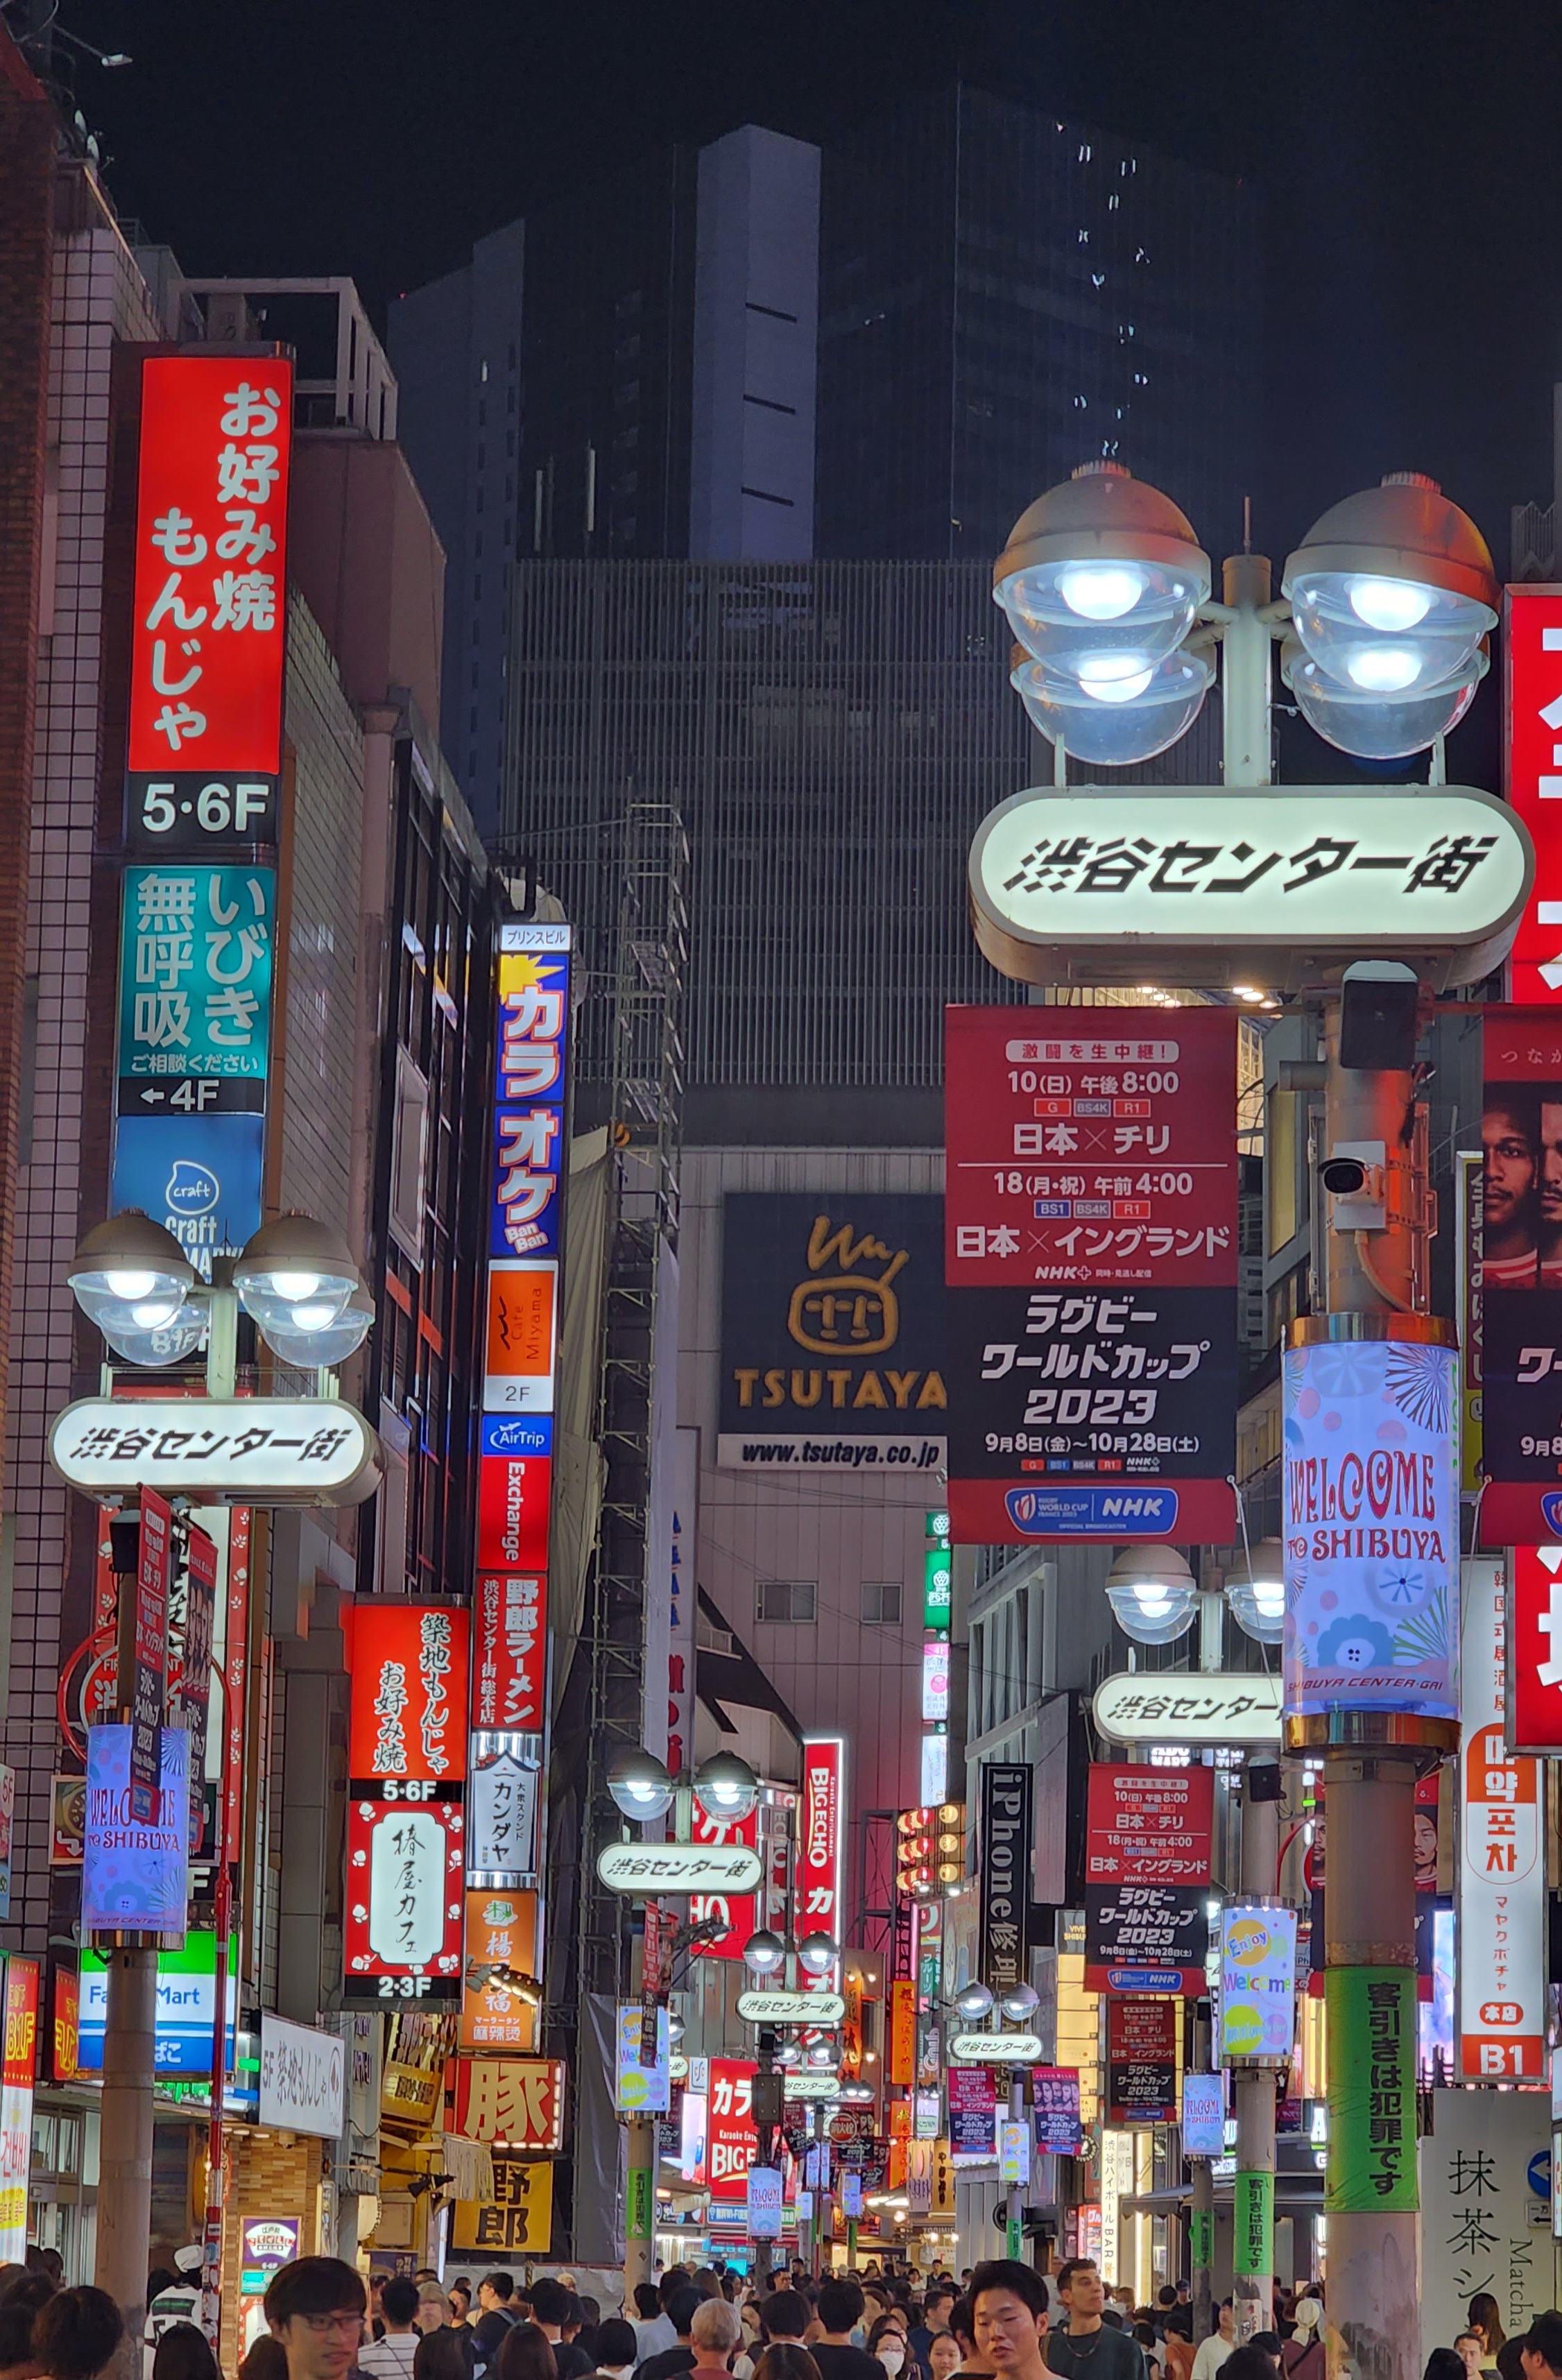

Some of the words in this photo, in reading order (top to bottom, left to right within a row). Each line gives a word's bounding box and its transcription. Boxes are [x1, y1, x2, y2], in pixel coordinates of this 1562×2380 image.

[211, 382, 280, 632] お好み焼
[146, 506, 207, 751] もんじゃ
[1002, 834, 1500, 894] 渋谷センター街
[507, 929, 565, 945] プリンスビル
[133, 873, 196, 1048] 無呼吸
[204, 873, 269, 1047] いびき
[130, 1054, 259, 1073] ご相談ください
[170, 1079, 220, 1111] 4F
[498, 984, 565, 1226] カラオケ
[1047, 1103, 1058, 1113] G
[1076, 1103, 1108, 1113] BS4K
[1124, 1103, 1140, 1113] R1
[1041, 1204, 1064, 1215] BS1
[1076, 1204, 1108, 1215] BS4K
[1124, 1204, 1140, 1215] R1
[511, 1305, 524, 1341] Cafe
[526, 1287, 543, 1360] Miyama
[1025, 1294, 1157, 1334] ラグビー
[981, 1339, 1211, 1380] ワールドカップ
[506, 1386, 530, 1402] 2F
[734, 1369, 947, 1409] TSUTAYA
[1023, 1389, 1157, 1424] 2023
[70, 1428, 352, 1461] 渋谷センター街
[499, 1432, 545, 1448] AirTrip
[742, 1441, 939, 1467] www.tsutaya.co.jp
[1288, 1450, 1435, 1525] WELCOME
[502, 1462, 525, 1561] Exchange
[1102, 1498, 1163, 1516] NHK
[1287, 1538, 1307, 1560] TO
[1312, 1528, 1447, 1564] SHIBUYA
[502, 1579, 539, 1727] 野郎ラーメン
[420, 1613, 452, 1775] 築地もんじゃ
[1287, 1677, 1345, 1693] SHIBUYA
[372, 1661, 407, 1774] お好み焼
[811, 1768, 830, 1807] BIG
[103, 1831, 180, 1852] SHIBUYA
[809, 1810, 827, 1867] ECHO
[607, 1859, 753, 1877] 渋谷センター街
[392, 1828, 425, 1953] 椿屋カフェ
[1119, 1888, 1176, 1906] ラグビー
[1099, 1909, 1198, 1926] ワールドカップ
[1116, 1928, 1174, 1944] 2023
[1228, 1931, 1267, 1958] Enjoy
[486, 1931, 513, 2013] 楊福
[1149, 1974, 1176, 1984] NHK
[1224, 1973, 1291, 1993] Welcome
[89, 1985, 200, 2005] FaMart
[743, 2001, 838, 2013] 渋谷センター街
[475, 2017, 520, 2025] マーラータン
[1485, 2005, 1517, 2021] 本店
[958, 2041, 1036, 2052] 渋谷センター街
[1480, 2045, 1523, 2074] B1
[263, 2050, 274, 2089] 5F
[464, 2060, 550, 2141] 豚
[1127, 2086, 1159, 2096] 2023
[1368, 1983, 1402, 2195] 客引きは犯罪です
[712, 2143, 744, 2178] BIG
[476, 2161, 531, 2248] 野郎
[1248, 2179, 1263, 2268] 客引きは犯罪です
[1509, 2238, 1534, 2327] Matcha
